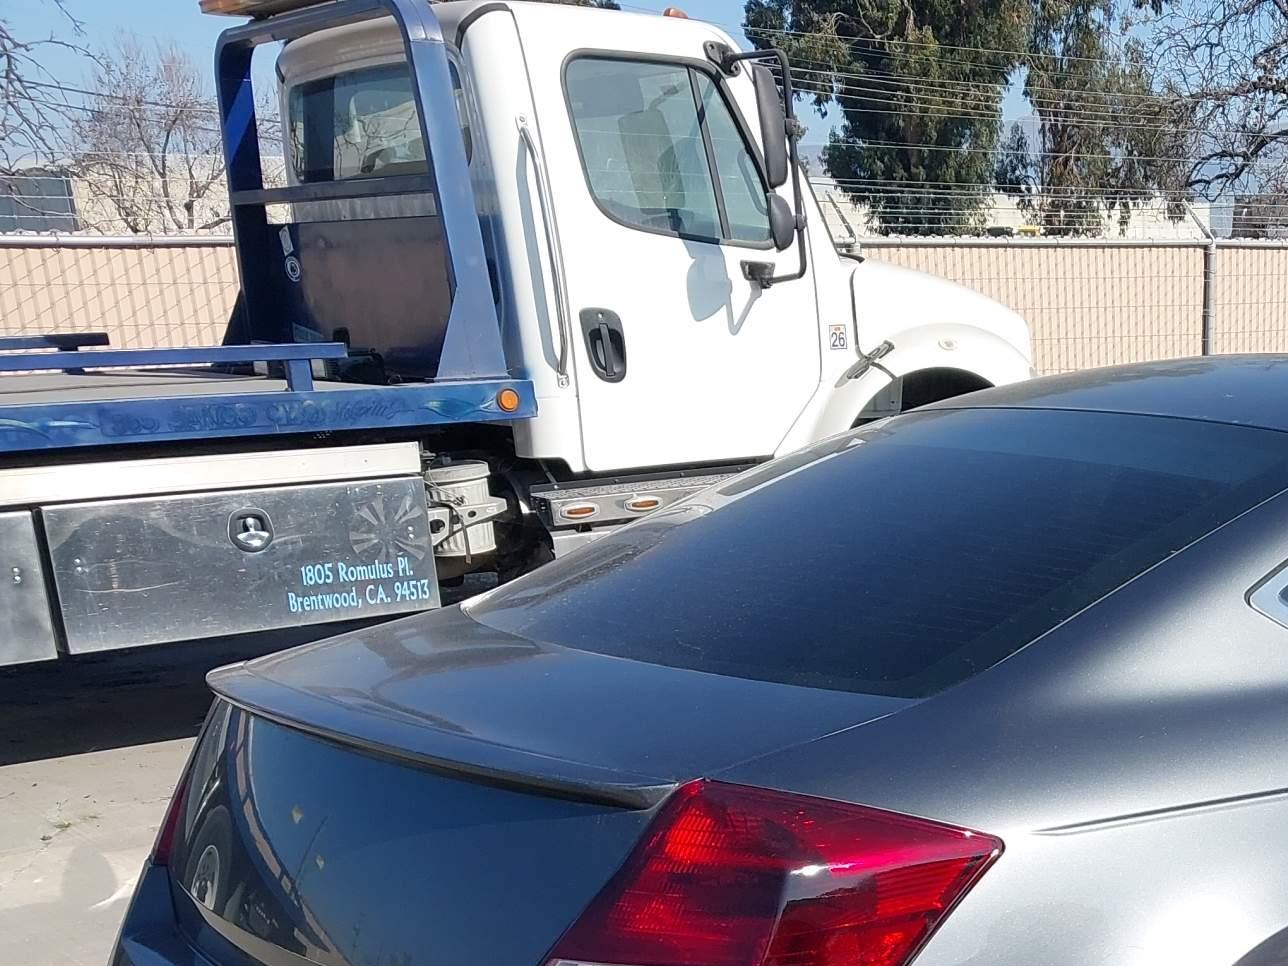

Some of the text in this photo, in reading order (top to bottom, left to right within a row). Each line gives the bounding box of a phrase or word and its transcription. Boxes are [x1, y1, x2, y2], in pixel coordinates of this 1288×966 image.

[832, 332, 845, 347] 26
[301, 556, 414, 585] 1805 Romulus Pl.
[288, 579, 430, 612] Brentwood, CA. 94513
